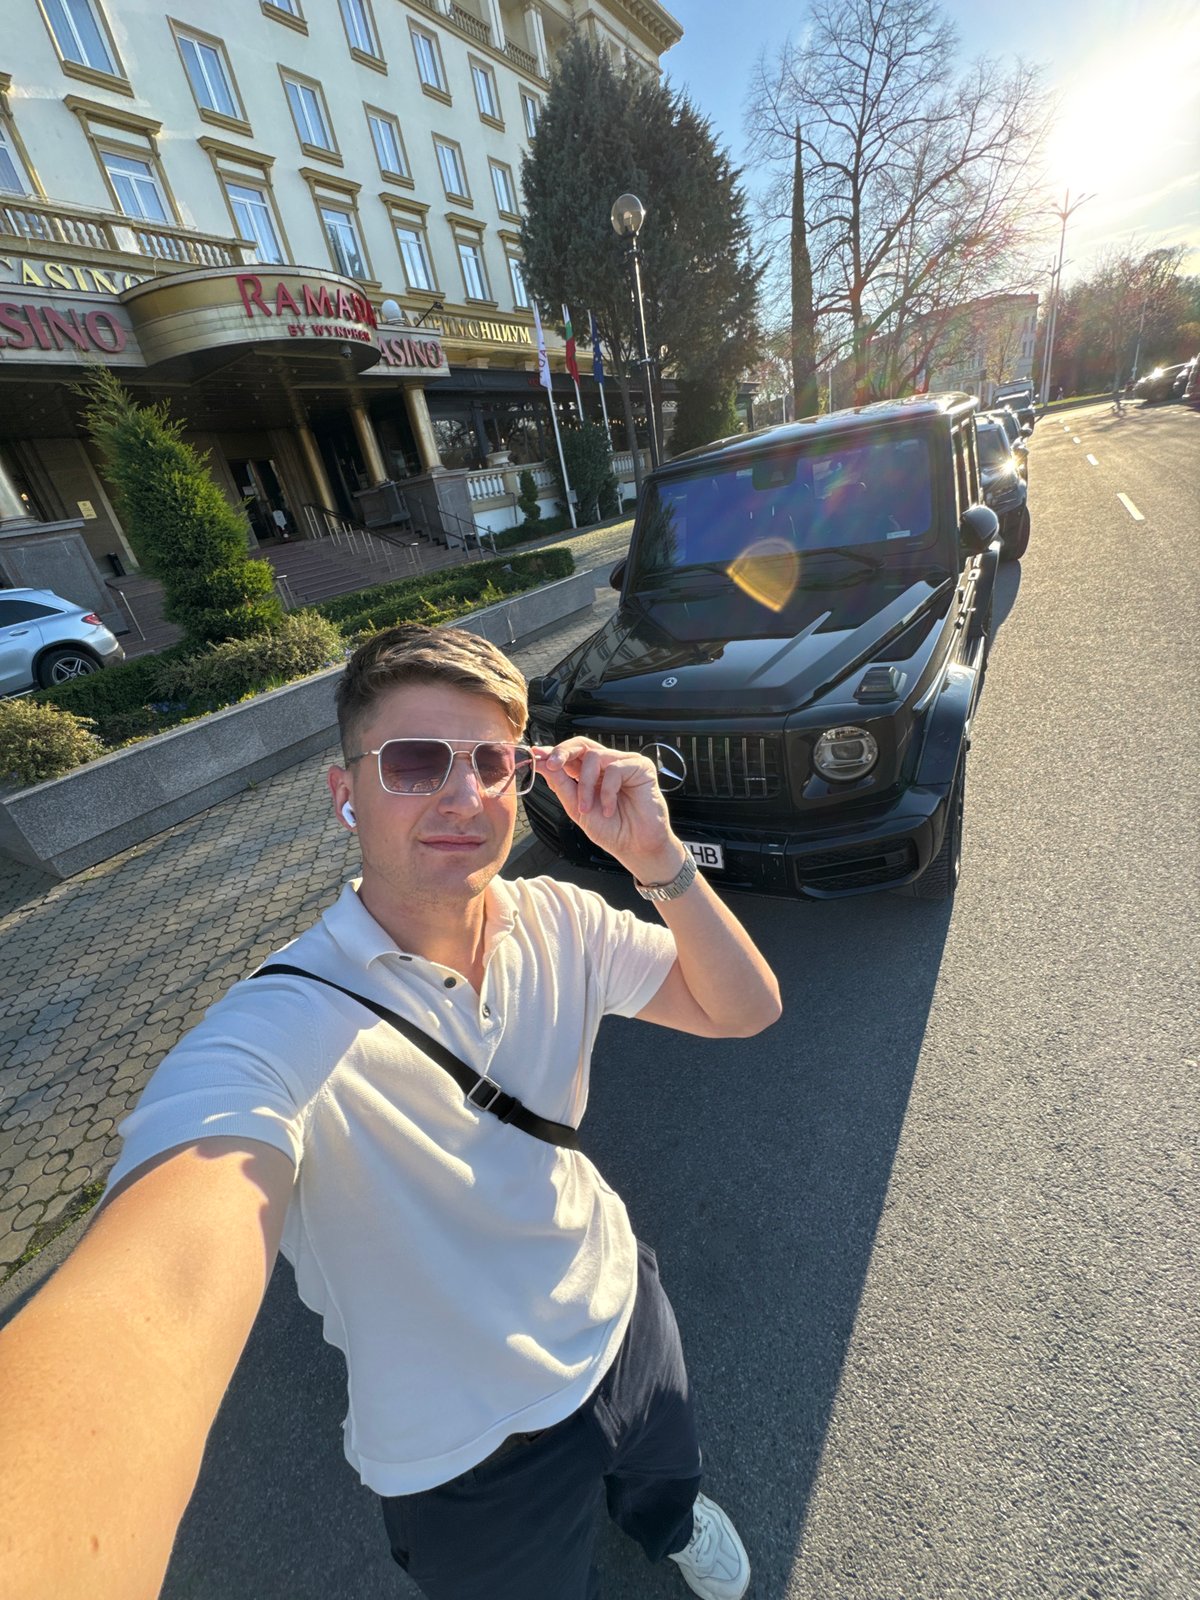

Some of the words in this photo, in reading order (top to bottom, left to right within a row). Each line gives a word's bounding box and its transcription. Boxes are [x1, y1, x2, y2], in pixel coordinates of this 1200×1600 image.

[236, 274, 377, 330] RAMAD
[0, 302, 126, 353] SINO
[288, 324, 305, 337] BY
[377, 336, 444, 369] ASINO
[690, 844, 719, 865] HB
